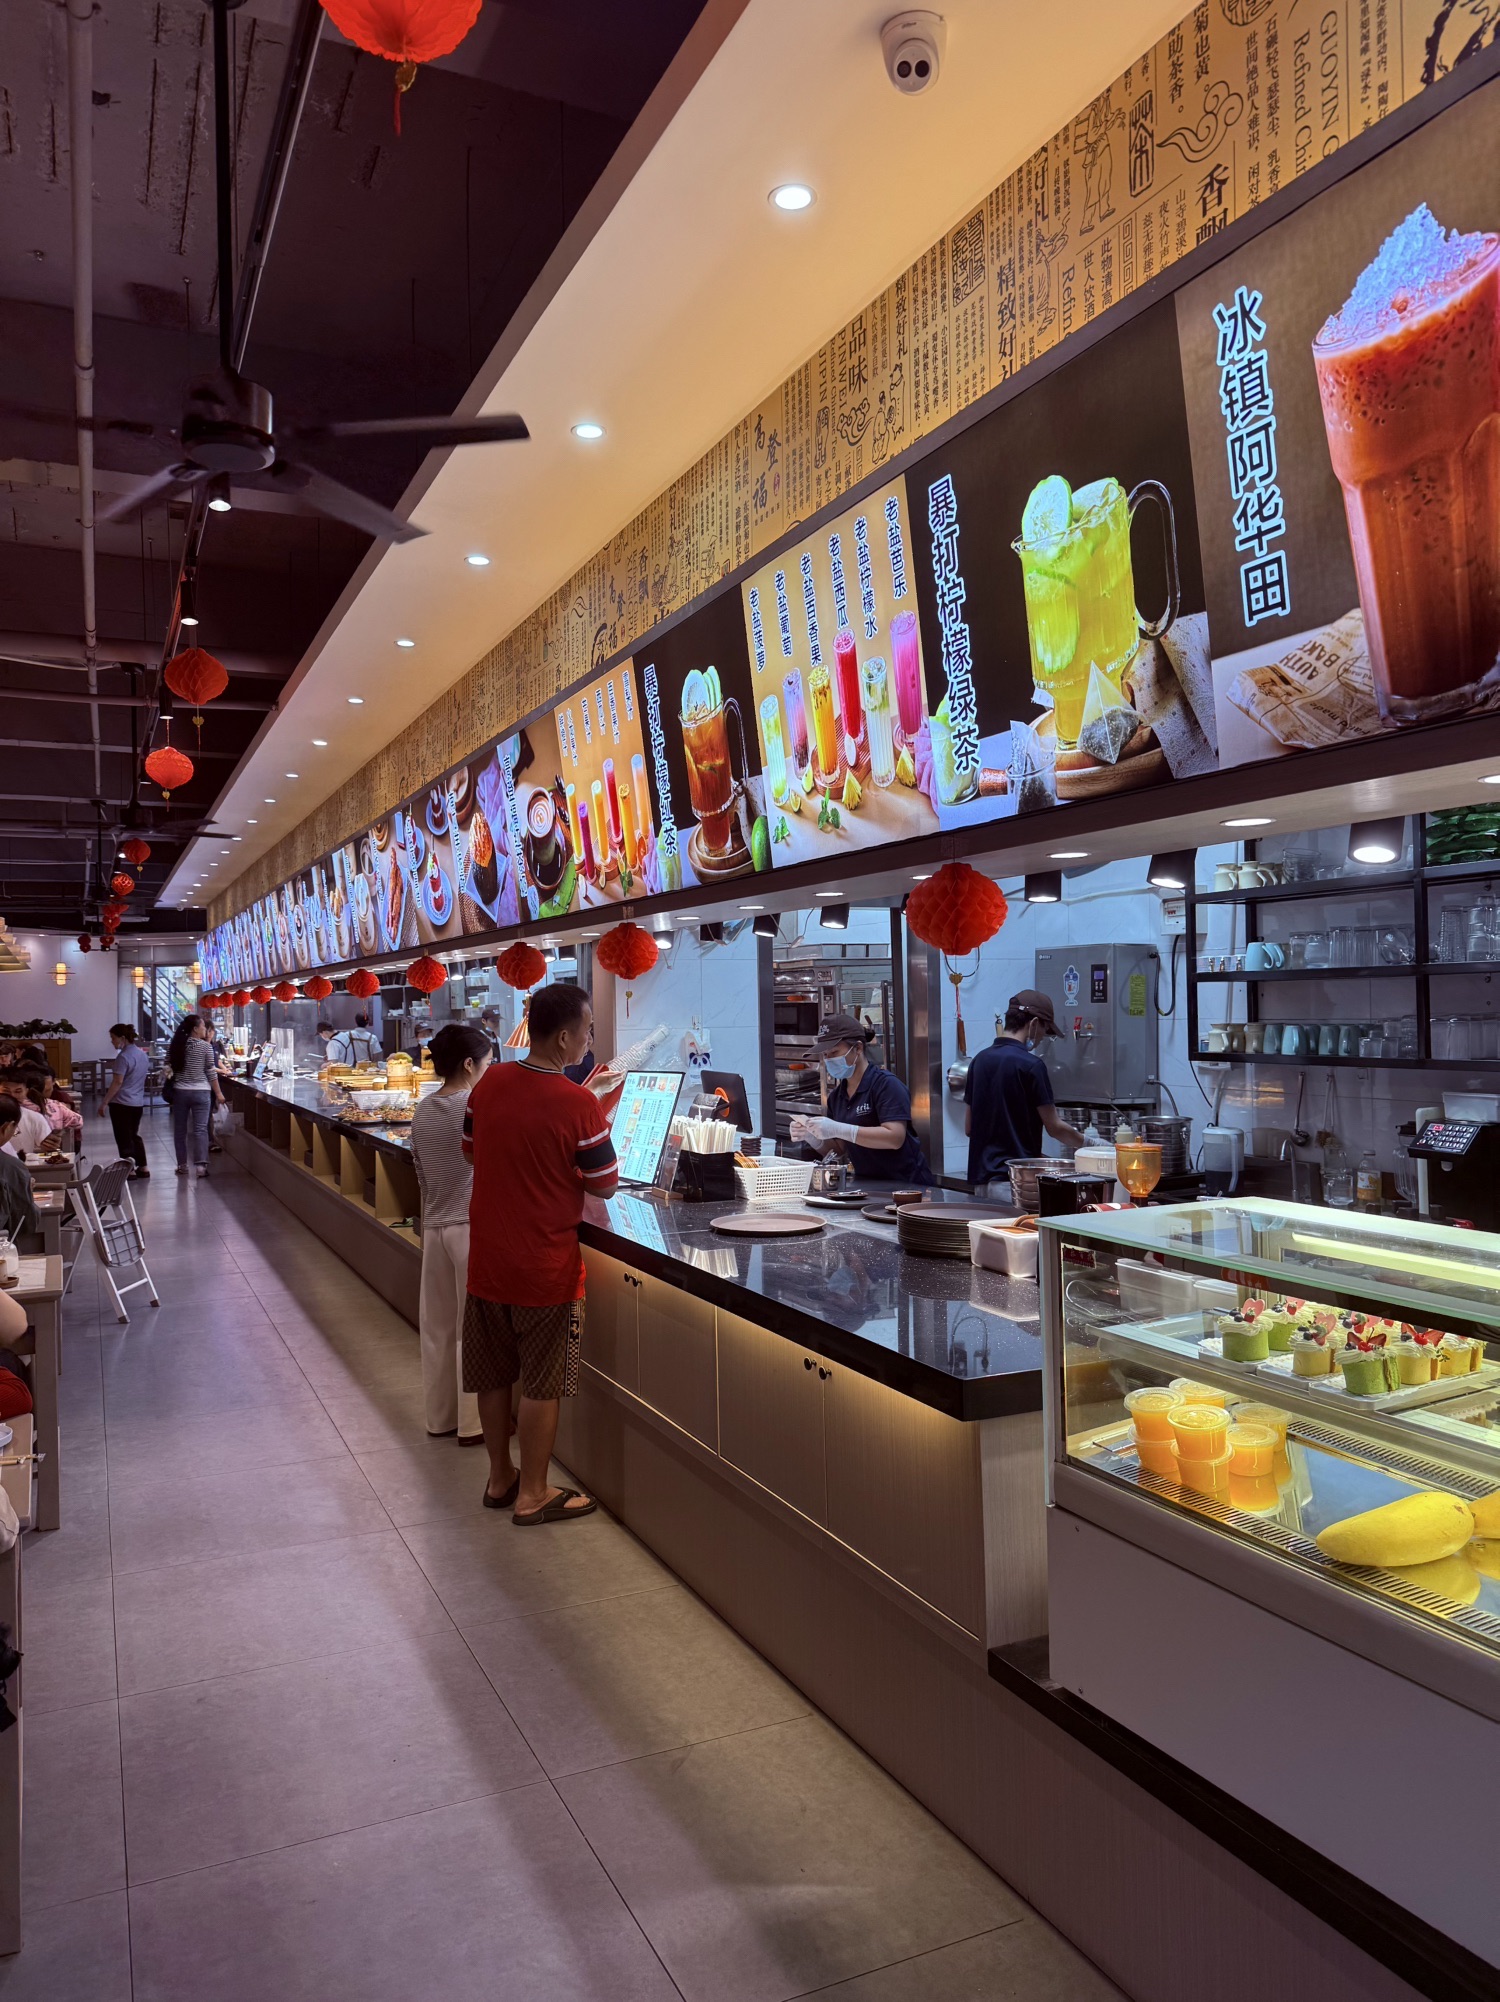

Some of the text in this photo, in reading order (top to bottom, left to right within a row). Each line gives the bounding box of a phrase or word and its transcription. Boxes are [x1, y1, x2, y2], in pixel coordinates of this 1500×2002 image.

[1294, 28, 1312, 124] Refined
[1320, 10, 1339, 131] GUOYIN
[1083, 249, 1095, 321] 世人饮酒
[1101, 237, 1113, 308] 此物清高
[838, 329, 847, 409] PINWEI
[849, 315, 868, 395] 品味
[1214, 287, 1289, 625] 冰镇阿华田
[829, 533, 848, 630] 老盐西瓜
[854, 516, 877, 639] 老盐柠檬水
[885, 496, 907, 599] 老盐芭乐
[800, 553, 822, 666] 老盐百香果
[928, 474, 979, 774] 暴打柠檬绿茶
[644, 663, 677, 857] 暴打柠檬红茶
